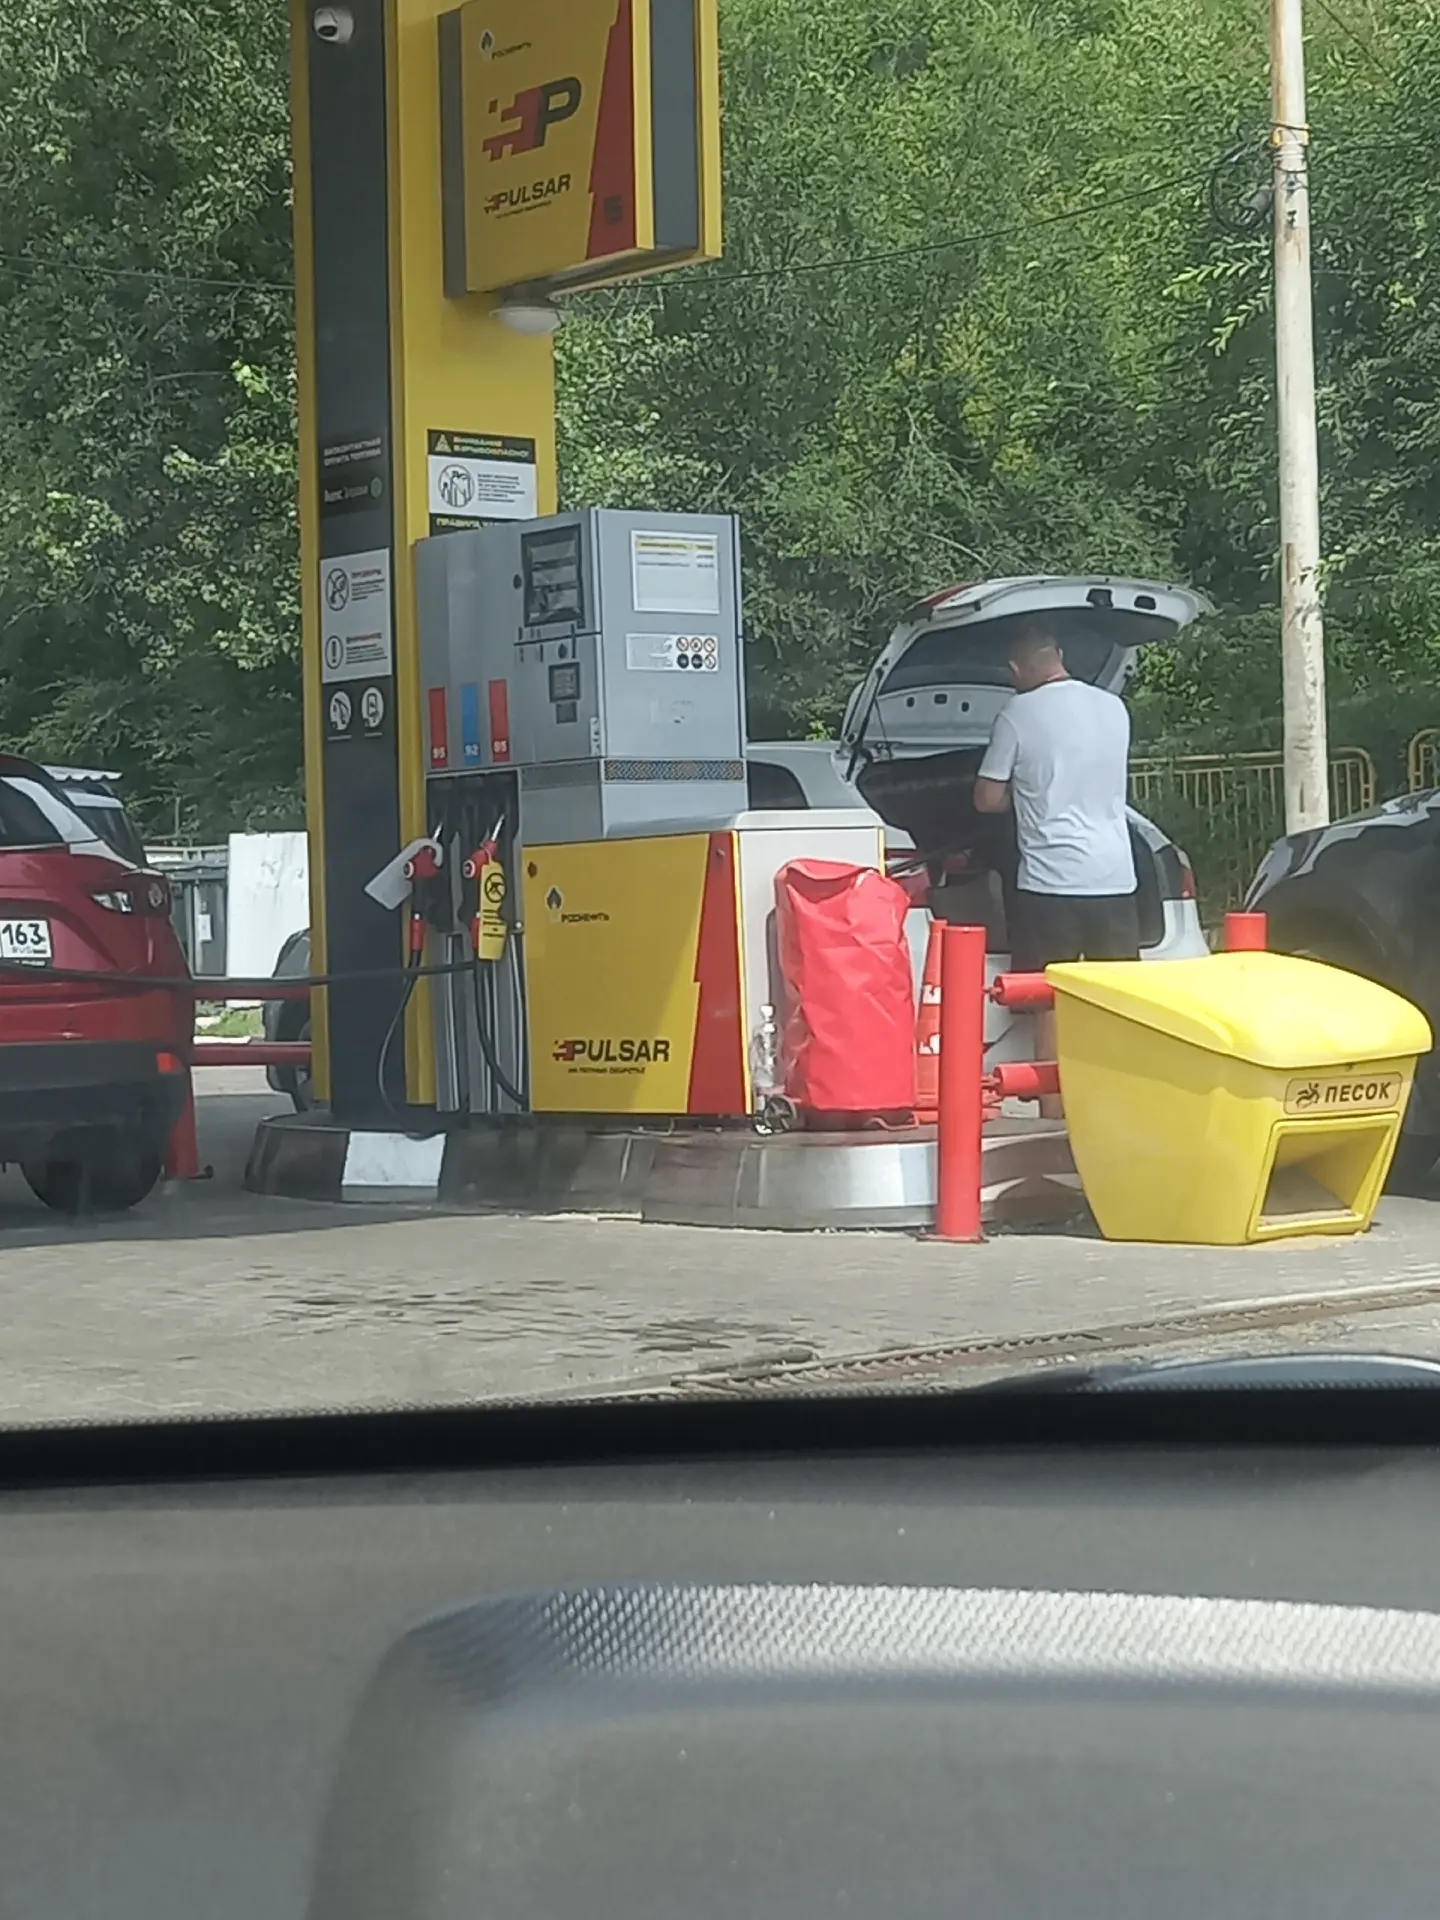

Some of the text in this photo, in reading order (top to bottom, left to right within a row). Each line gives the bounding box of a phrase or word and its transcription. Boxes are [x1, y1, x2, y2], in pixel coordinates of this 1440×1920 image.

[490, 173, 571, 211] PULSAR
[464, 743, 479, 757] 92
[2, 923, 42, 946] 163
[564, 1038, 671, 1063] PULSAR
[1324, 1080, 1392, 1104] ПЕСОК
